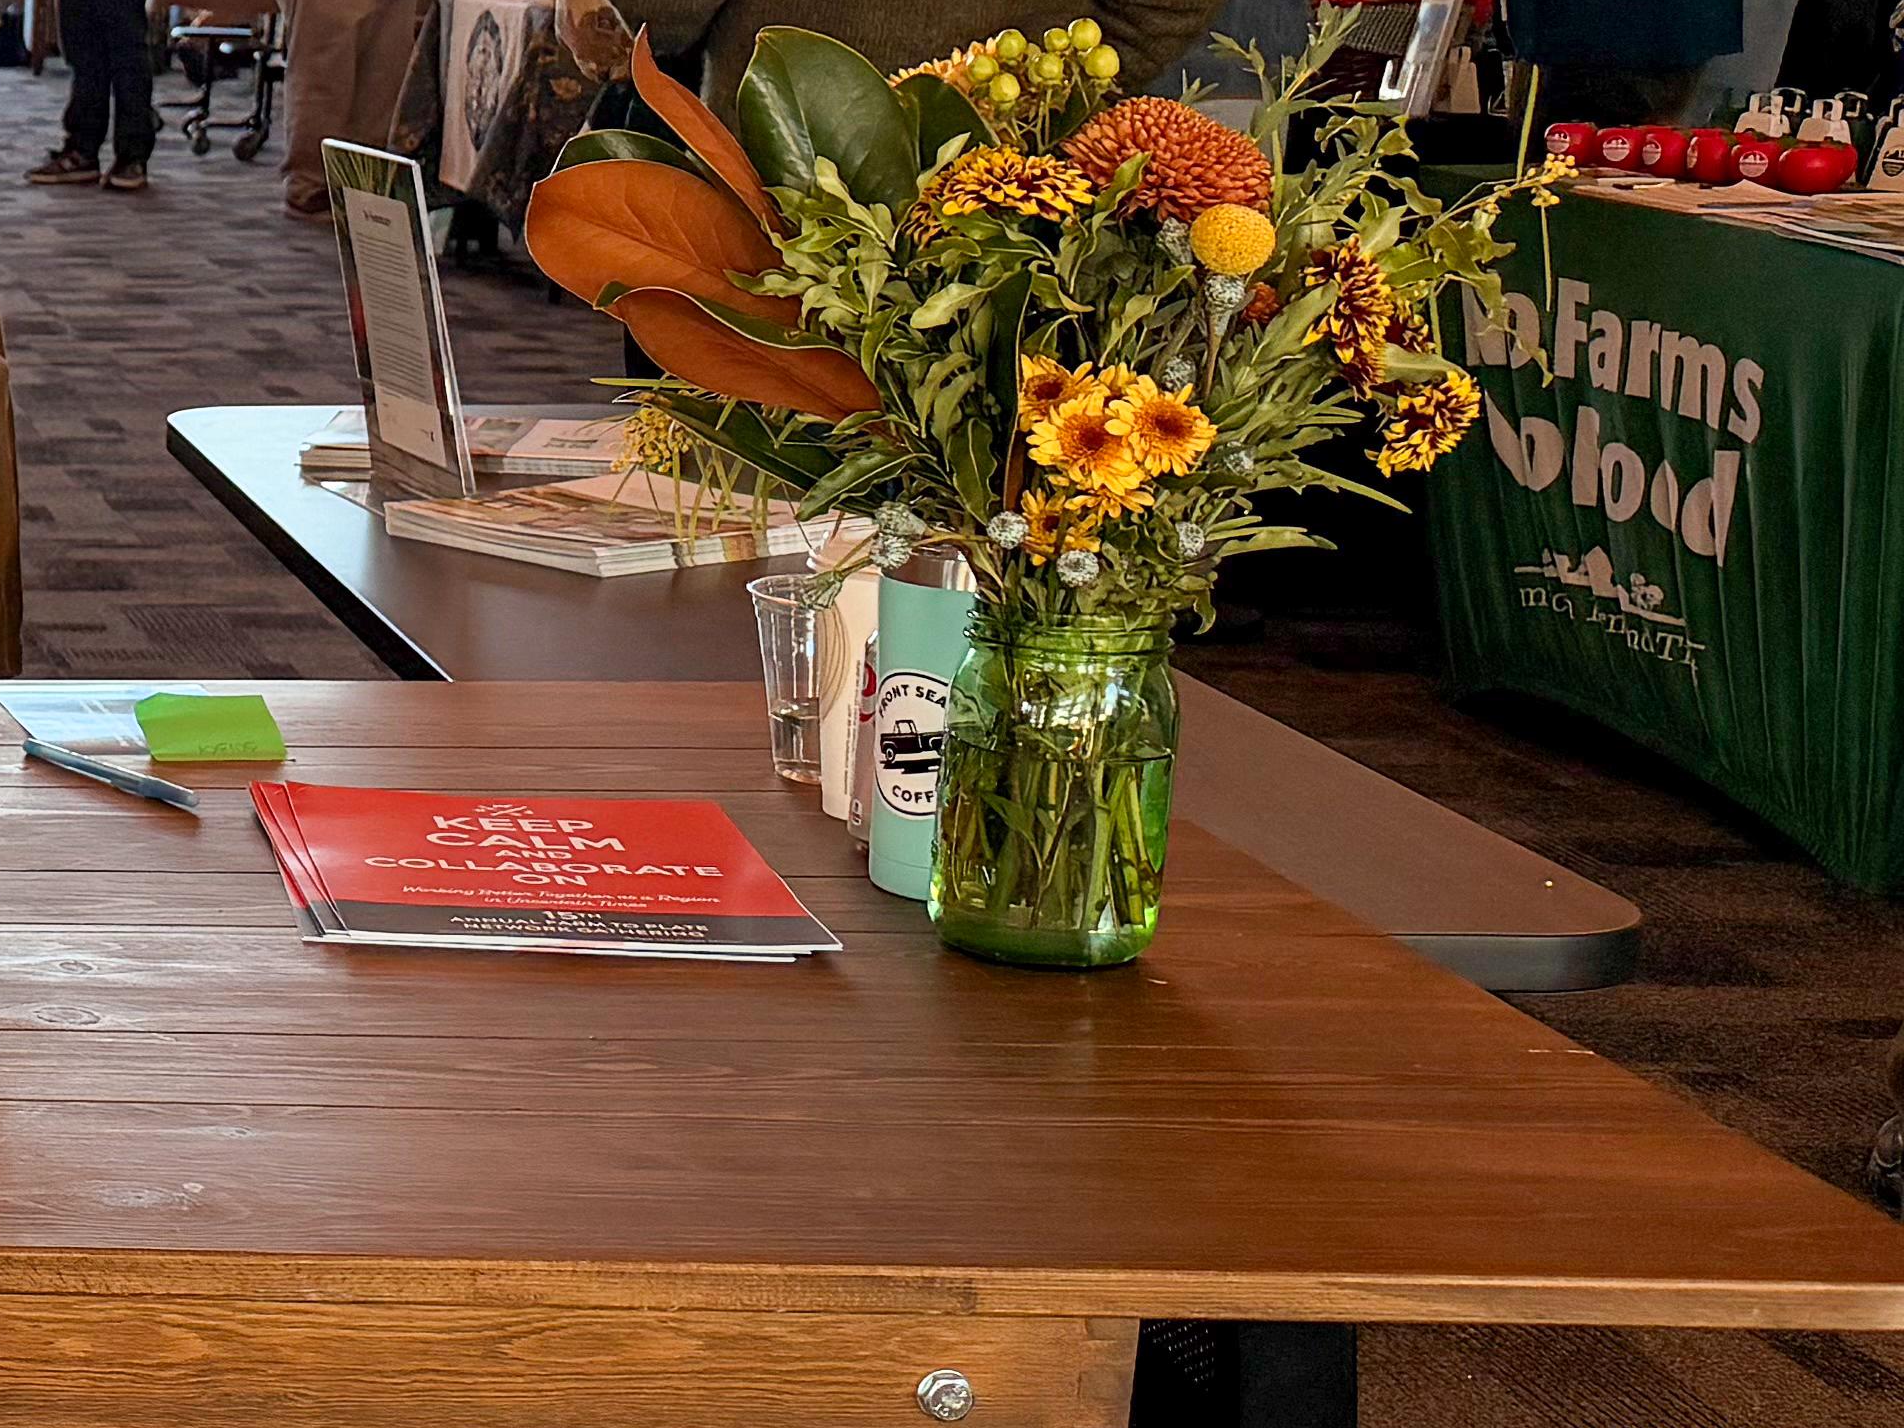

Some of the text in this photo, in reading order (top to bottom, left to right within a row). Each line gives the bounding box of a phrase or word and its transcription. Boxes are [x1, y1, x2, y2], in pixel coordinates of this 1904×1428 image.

[1461, 277, 1764, 444] No Farms
[878, 684, 948, 718] FRONT SEA
[892, 784, 935, 803] COFF
[432, 815, 594, 833] KEEP
[425, 833, 626, 852] CALM
[495, 849, 572, 860] AND
[365, 857, 725, 877] COLLABORATE
[512, 873, 588, 887] ON
[402, 885, 475, 896] Working
[478, 888, 533, 897] Better
[538, 890, 615, 901] Together
[656, 893, 721, 904] Region
[505, 896, 595, 907] Uncertain
[598, 899, 648, 909] Times
[449, 916, 710, 932] ANNUAL FARM TO PLATE
[541, 910, 602, 921] 15TH
[463, 923, 705, 938] NETWORK GATHERING
